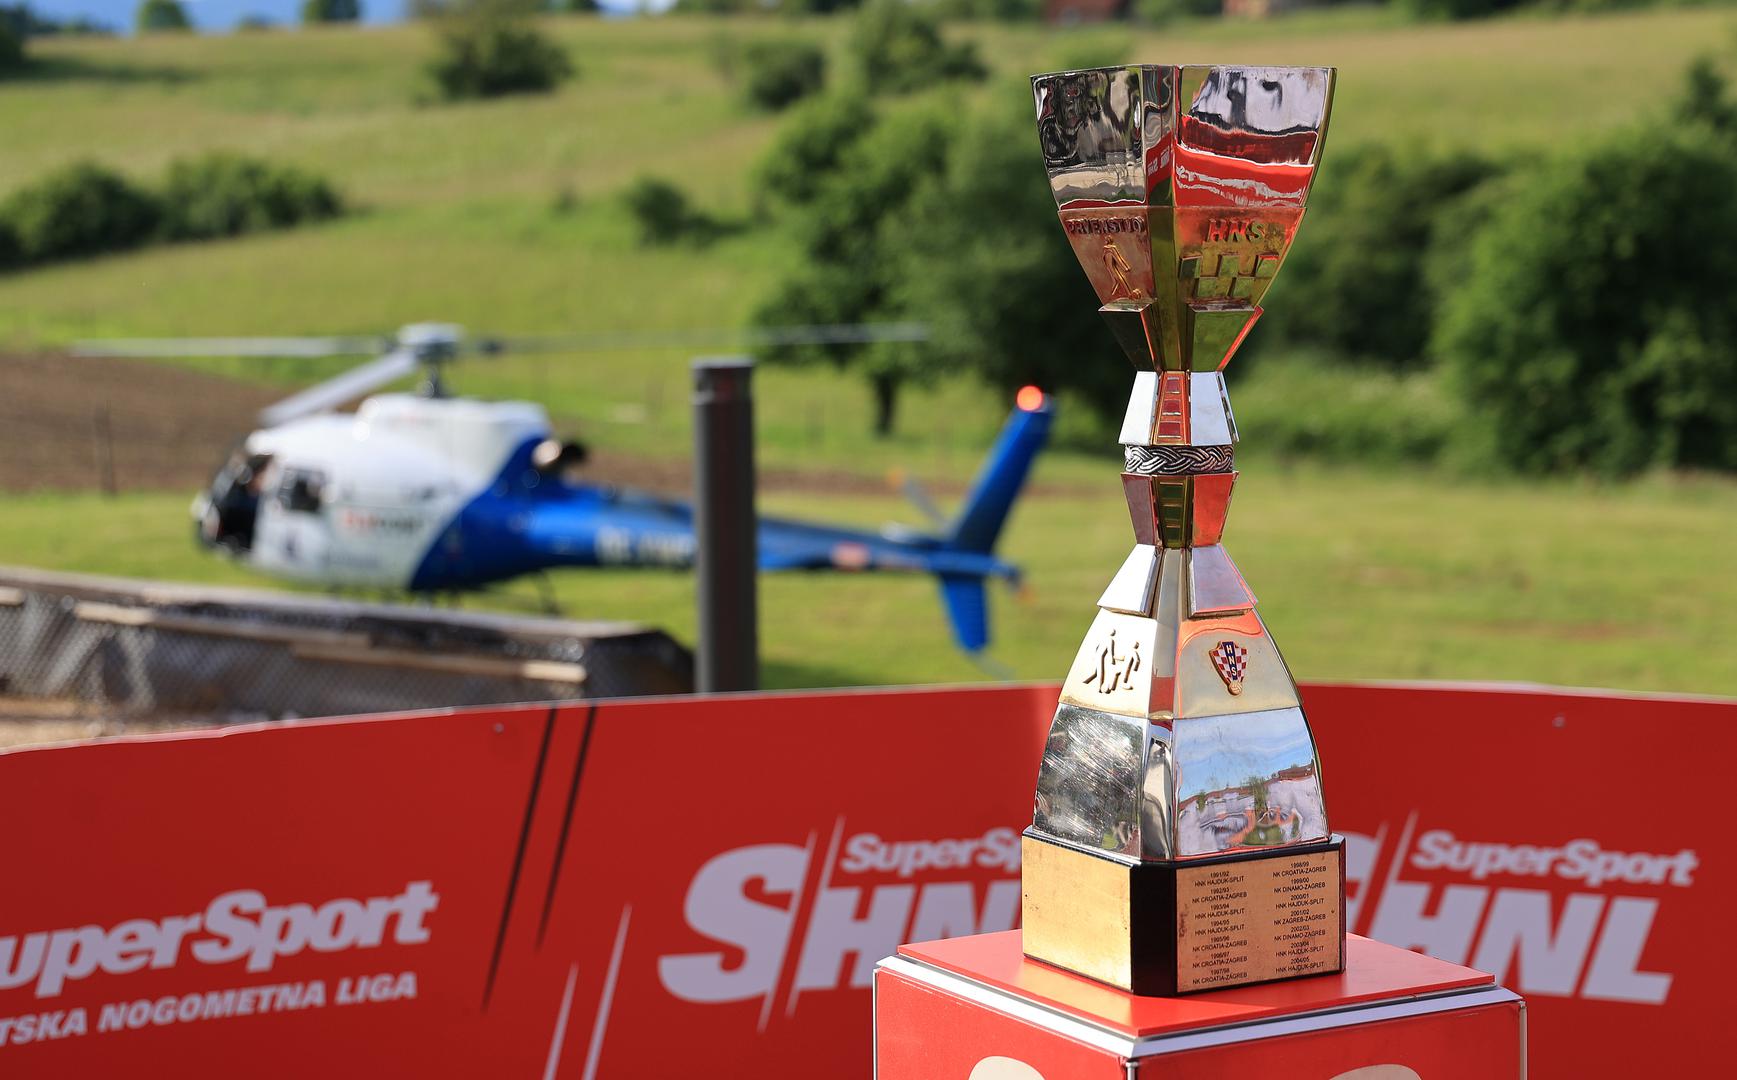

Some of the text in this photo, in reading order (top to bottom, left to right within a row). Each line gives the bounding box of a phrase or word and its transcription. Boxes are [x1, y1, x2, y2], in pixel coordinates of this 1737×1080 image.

[1208, 218, 1265, 243] HNS
[1225, 644, 1237, 676] HNS
[1410, 829, 1700, 887] SuperSport
[1210, 870, 1229, 878] 1991/92
[1281, 866, 1326, 876] CROATIA-ZAGREB
[1207, 876, 1244, 886] HAJDUK-SPLIT
[1282, 882, 1325, 892] DINAMO-ZAGREB
[1201, 892, 1247, 902] CROATIA-ZAGREB
[1287, 898, 1324, 908] HAJDUK-SPLIT
[1207, 908, 1244, 918] HAJDUK-SPLIT
[1282, 914, 1326, 924] ZAGREB-ZAGREB
[1207, 924, 1244, 934] HAJDUK-SPLIT
[1282, 930, 1325, 940] DINAMO-ZAGREB
[1201, 940, 1247, 951] CROATIA-ZAGREB
[1287, 946, 1324, 956] HAJDUK-SPLIT
[1201, 956, 1247, 967] CROATIA-ZAGREB
[1287, 961, 1324, 971] HAJDUK-SPLIT
[1201, 972, 1247, 983] CROATIA-ZAGREB
[97, 981, 326, 1033] NOGOMETNA
[335, 971, 418, 1005] LIGA
